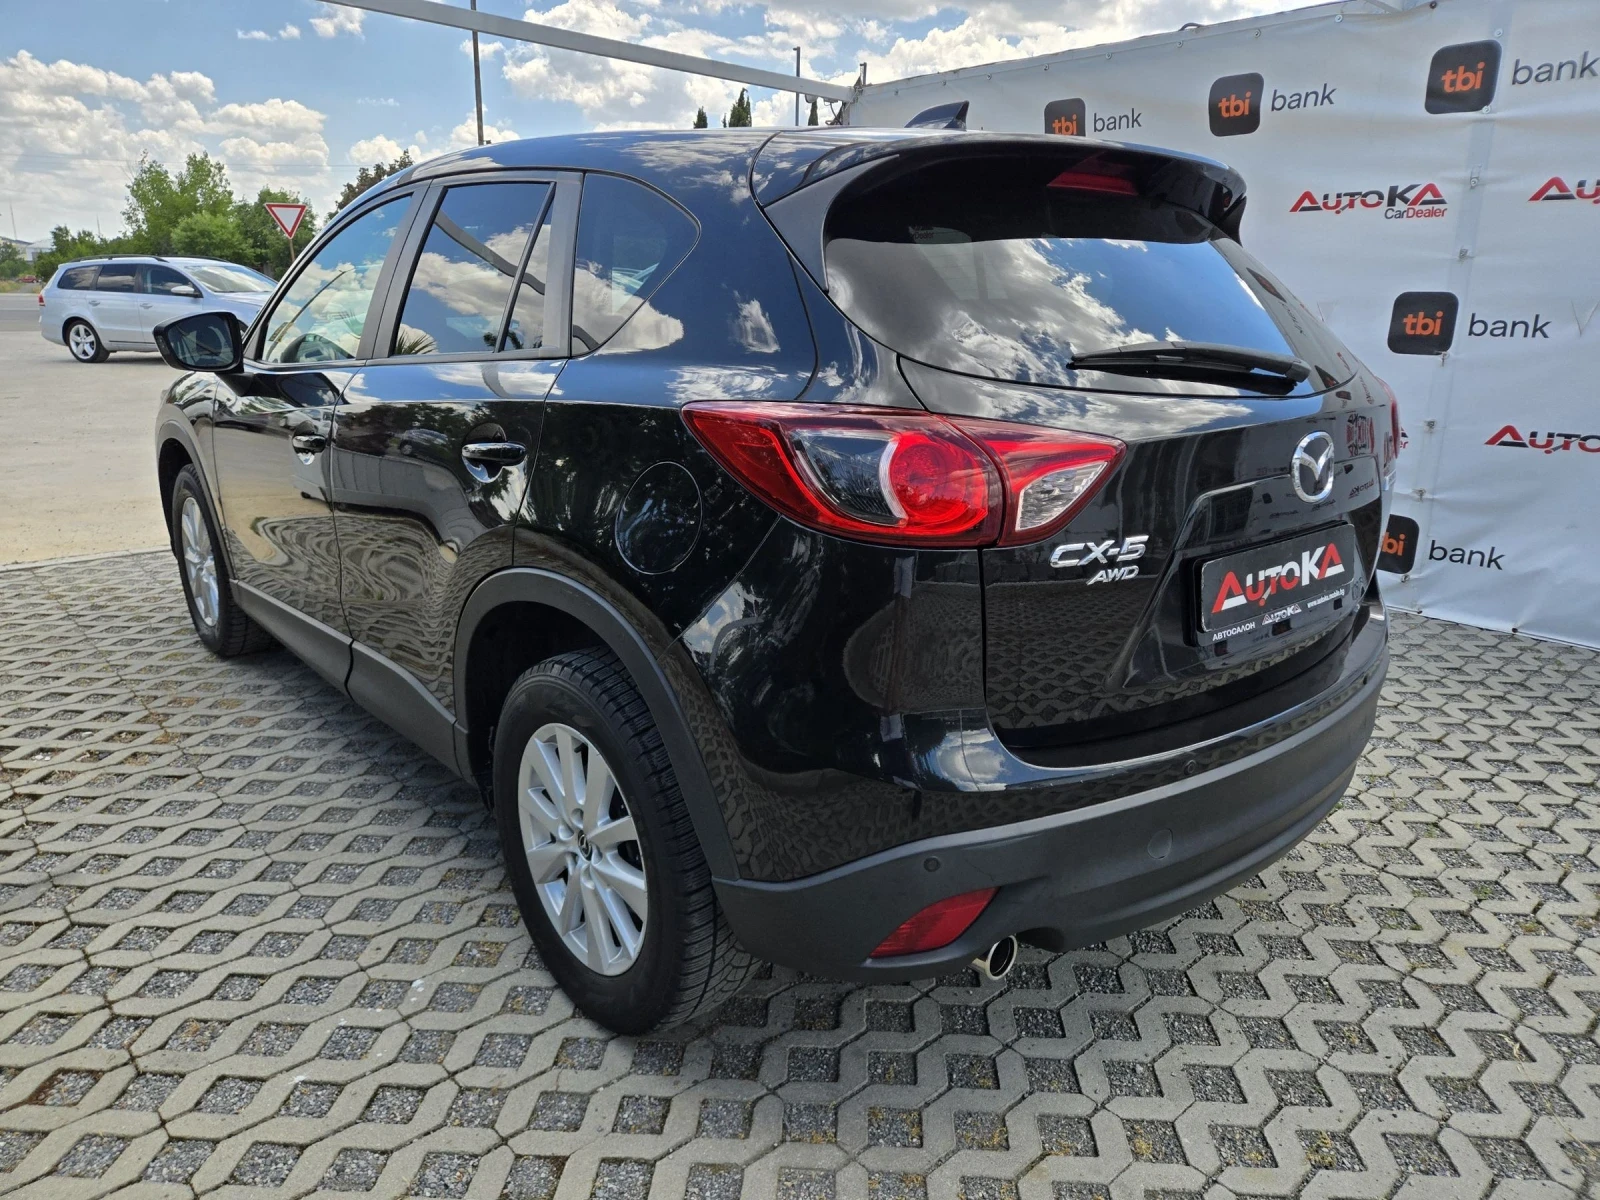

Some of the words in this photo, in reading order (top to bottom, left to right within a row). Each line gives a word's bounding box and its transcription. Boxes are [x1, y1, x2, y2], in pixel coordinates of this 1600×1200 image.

[1441, 61, 1486, 92] tbi
[1511, 50, 1600, 85] bank
[1218, 91, 1252, 118] tbi
[1271, 83, 1336, 112] bank
[1052, 114, 1077, 135] tbi
[1093, 108, 1142, 132] bank
[1289, 183, 1447, 215] AUTOKA
[1384, 206, 1448, 219] CarDealer
[1403, 311, 1443, 336] tbi
[1468, 313, 1552, 338] bank
[1050, 535, 1149, 568] CX-5
[1381, 532, 1406, 556] bi
[1428, 540, 1505, 570] bank
[1086, 565, 1140, 585] AWD
[1211, 542, 1345, 614] AUTOKA
[1212, 621, 1256, 642] АВТОСАЛОН
